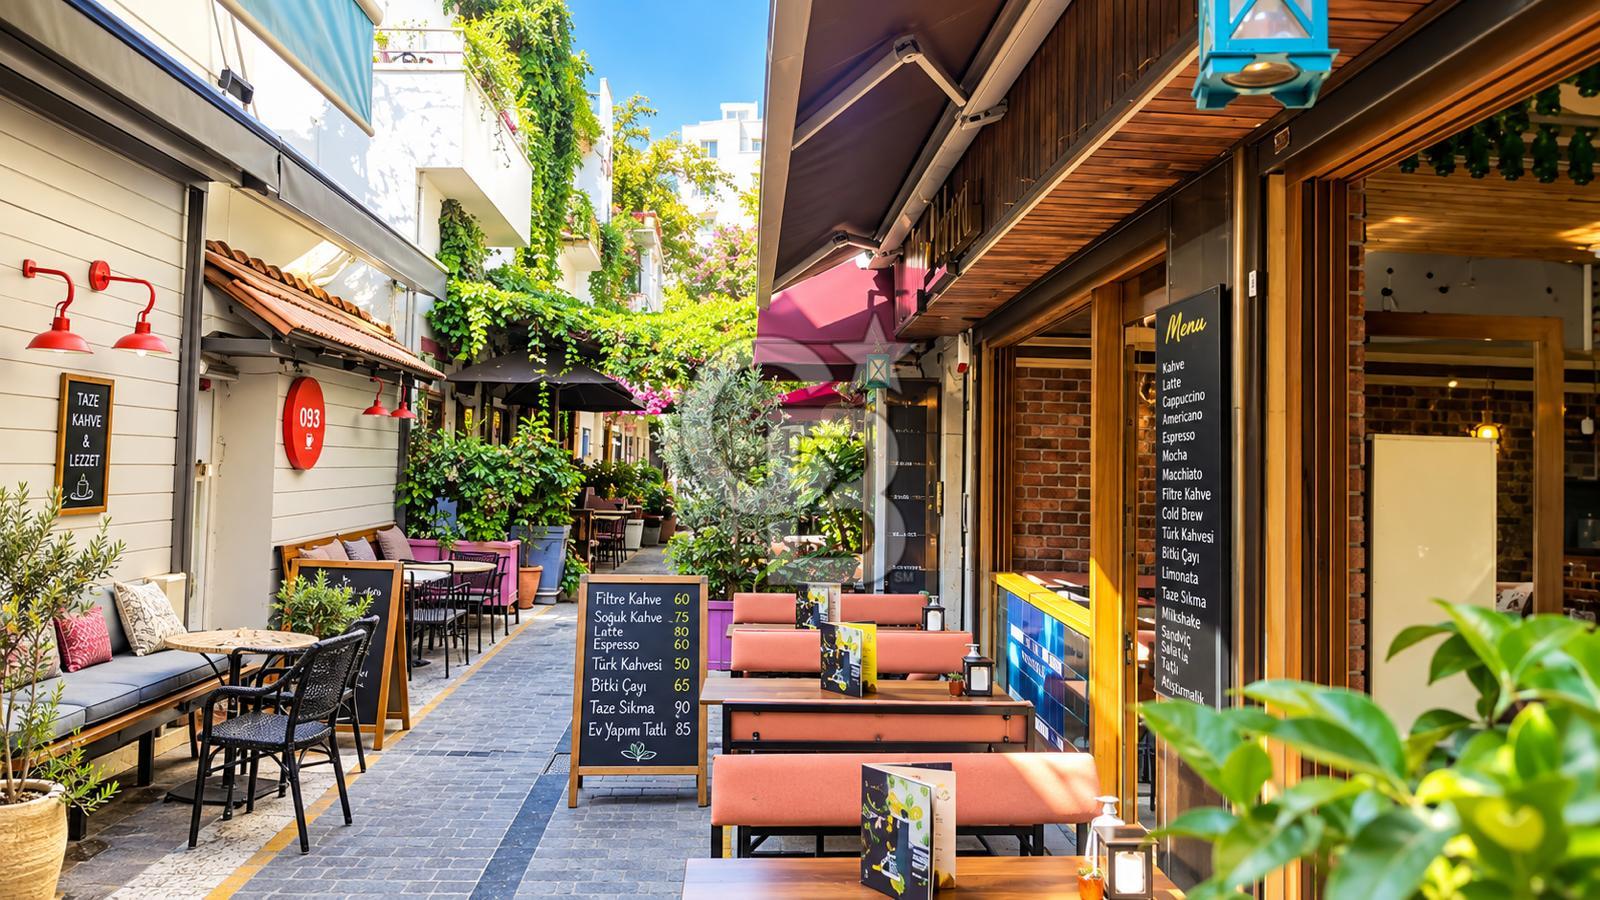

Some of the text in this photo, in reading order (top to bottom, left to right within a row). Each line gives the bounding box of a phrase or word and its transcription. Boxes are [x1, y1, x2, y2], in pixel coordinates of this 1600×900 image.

[1165, 311, 1207, 344] Menu
[1162, 360, 1185, 374] Kahve
[1162, 377, 1182, 391] Latte
[76, 391, 100, 408] TAZE
[1162, 390, 1205, 409] Cappuccino
[71, 413, 102, 428] KAHVE
[299, 407, 321, 429] 093
[1162, 410, 1203, 425] Americano
[82, 434, 91, 448] &
[1162, 430, 1195, 445] Espresso
[69, 454, 101, 468] LEZZET
[1162, 448, 1188, 462] Mocha
[1162, 467, 1203, 481] Macchiato
[1162, 487, 1211, 501] Filtre Kahve
[1162, 506, 1203, 521] Cold Brew
[1162, 526, 1214, 544] Türk Kahvesi
[1162, 546, 1200, 566] Bitki Çayı
[1161, 565, 1199, 584] Limonata
[596, 591, 690, 605] Filtre Kahve 60
[1161, 586, 1179, 602] Taze
[594, 610, 689, 627] Soğuk Kahve 75
[674, 626, 689, 637] 80
[593, 638, 690, 653] Espresso 60
[592, 656, 690, 671] Türk Kahvesi 50
[591, 677, 690, 697] Bitki Çayı 65
[590, 700, 616, 714] Taze
[674, 700, 690, 714] 90
[588, 721, 691, 742] Ev Yapımı Tatlı 85
